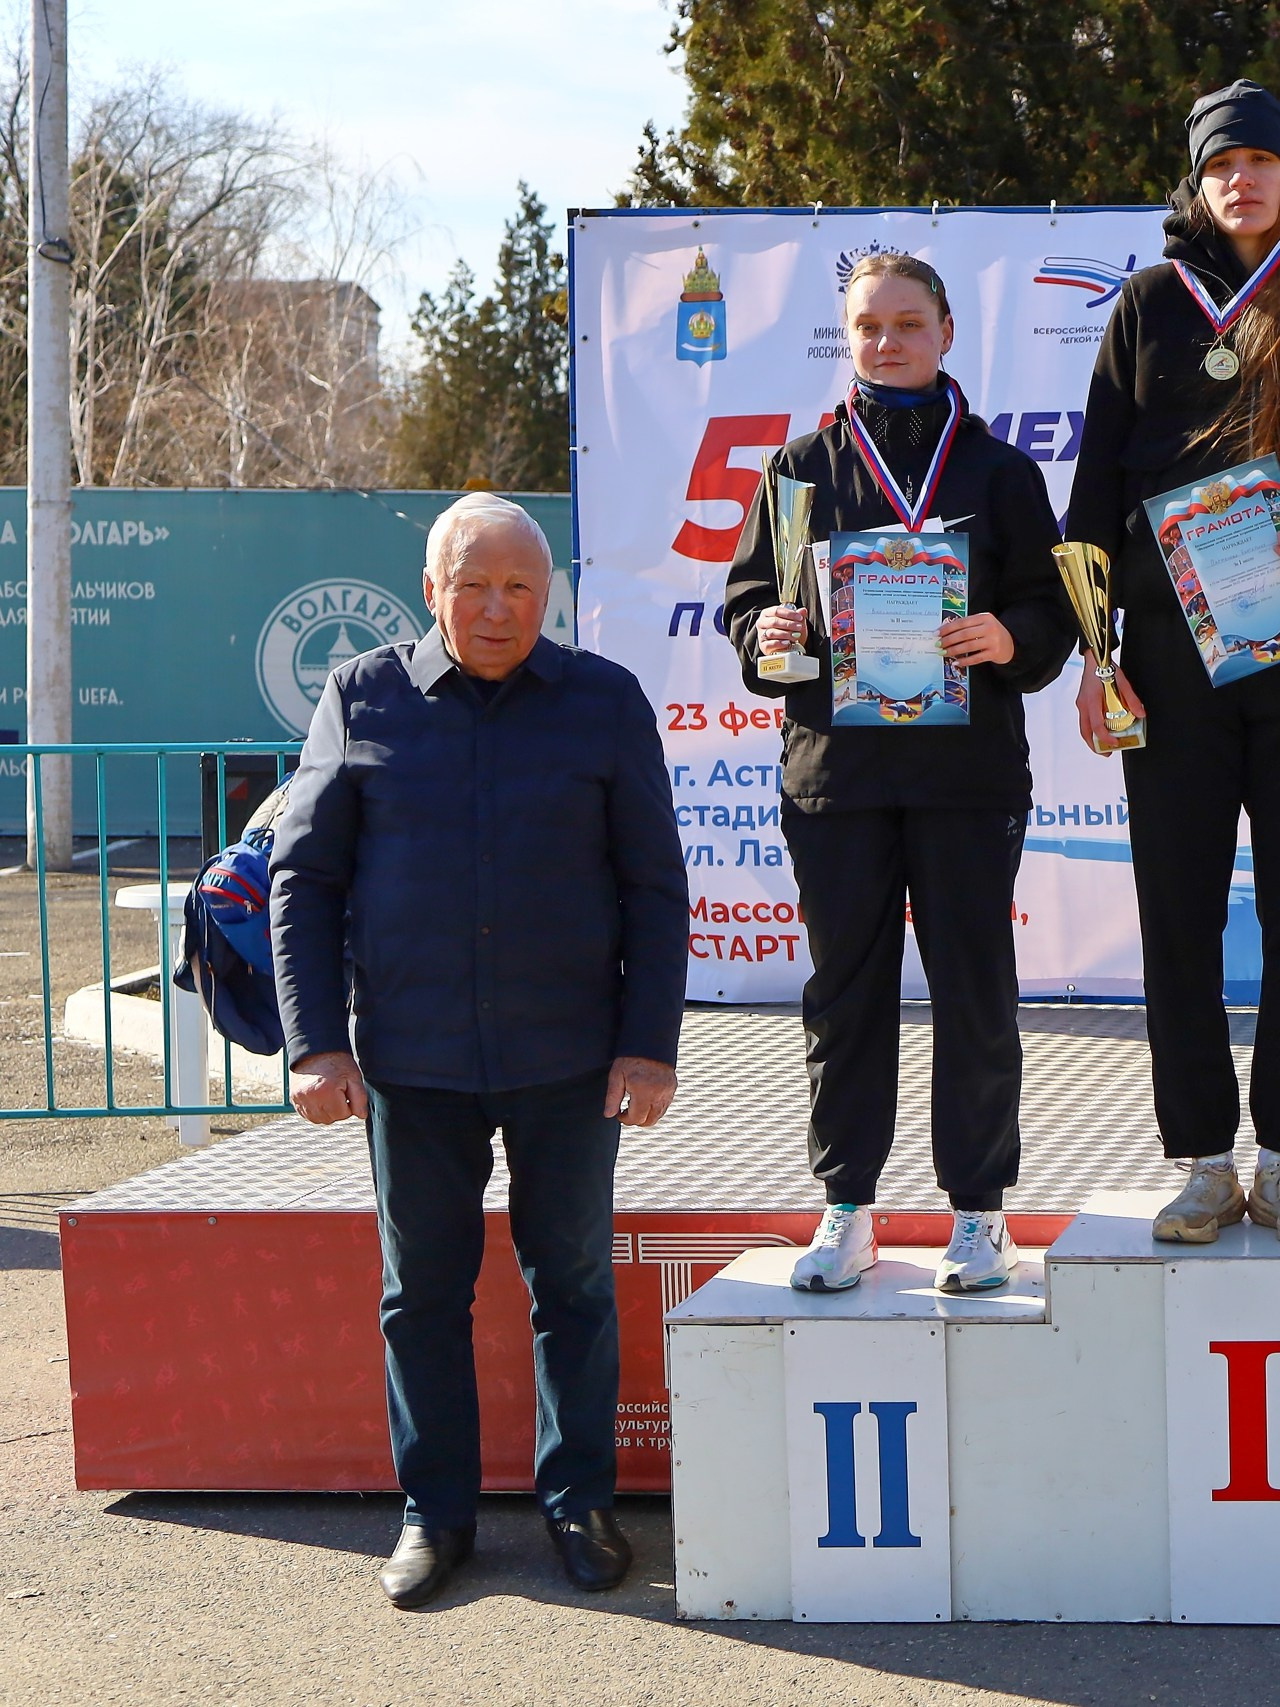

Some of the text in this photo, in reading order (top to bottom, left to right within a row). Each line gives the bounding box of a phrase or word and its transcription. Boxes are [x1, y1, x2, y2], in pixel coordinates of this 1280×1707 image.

[813, 327, 848, 340] МИНИС
[1033, 325, 1105, 335] ВСЕРОССИЙСКА
[1059, 335, 1104, 345] ЛЕГКОЙ АТ
[807, 344, 854, 360] РОССИЙС
[1185, 504, 1266, 542] ГРАМОТА
[858, 574, 940, 585] ГРАМОТА
[71, 581, 155, 599] ЛЬЧИКОВ
[280, 589, 403, 637] ВОЛГАРЬ
[79, 688, 124, 705] UEFA.
[665, 701, 785, 736] 23 фев
[674, 765, 696, 787] г.
[674, 805, 779, 831] стади
[688, 932, 800, 962] СТАРТ
[617, 1400, 669, 1413] оссийс
[615, 1437, 672, 1451] ов к тру
[812, 1401, 922, 1548] II
